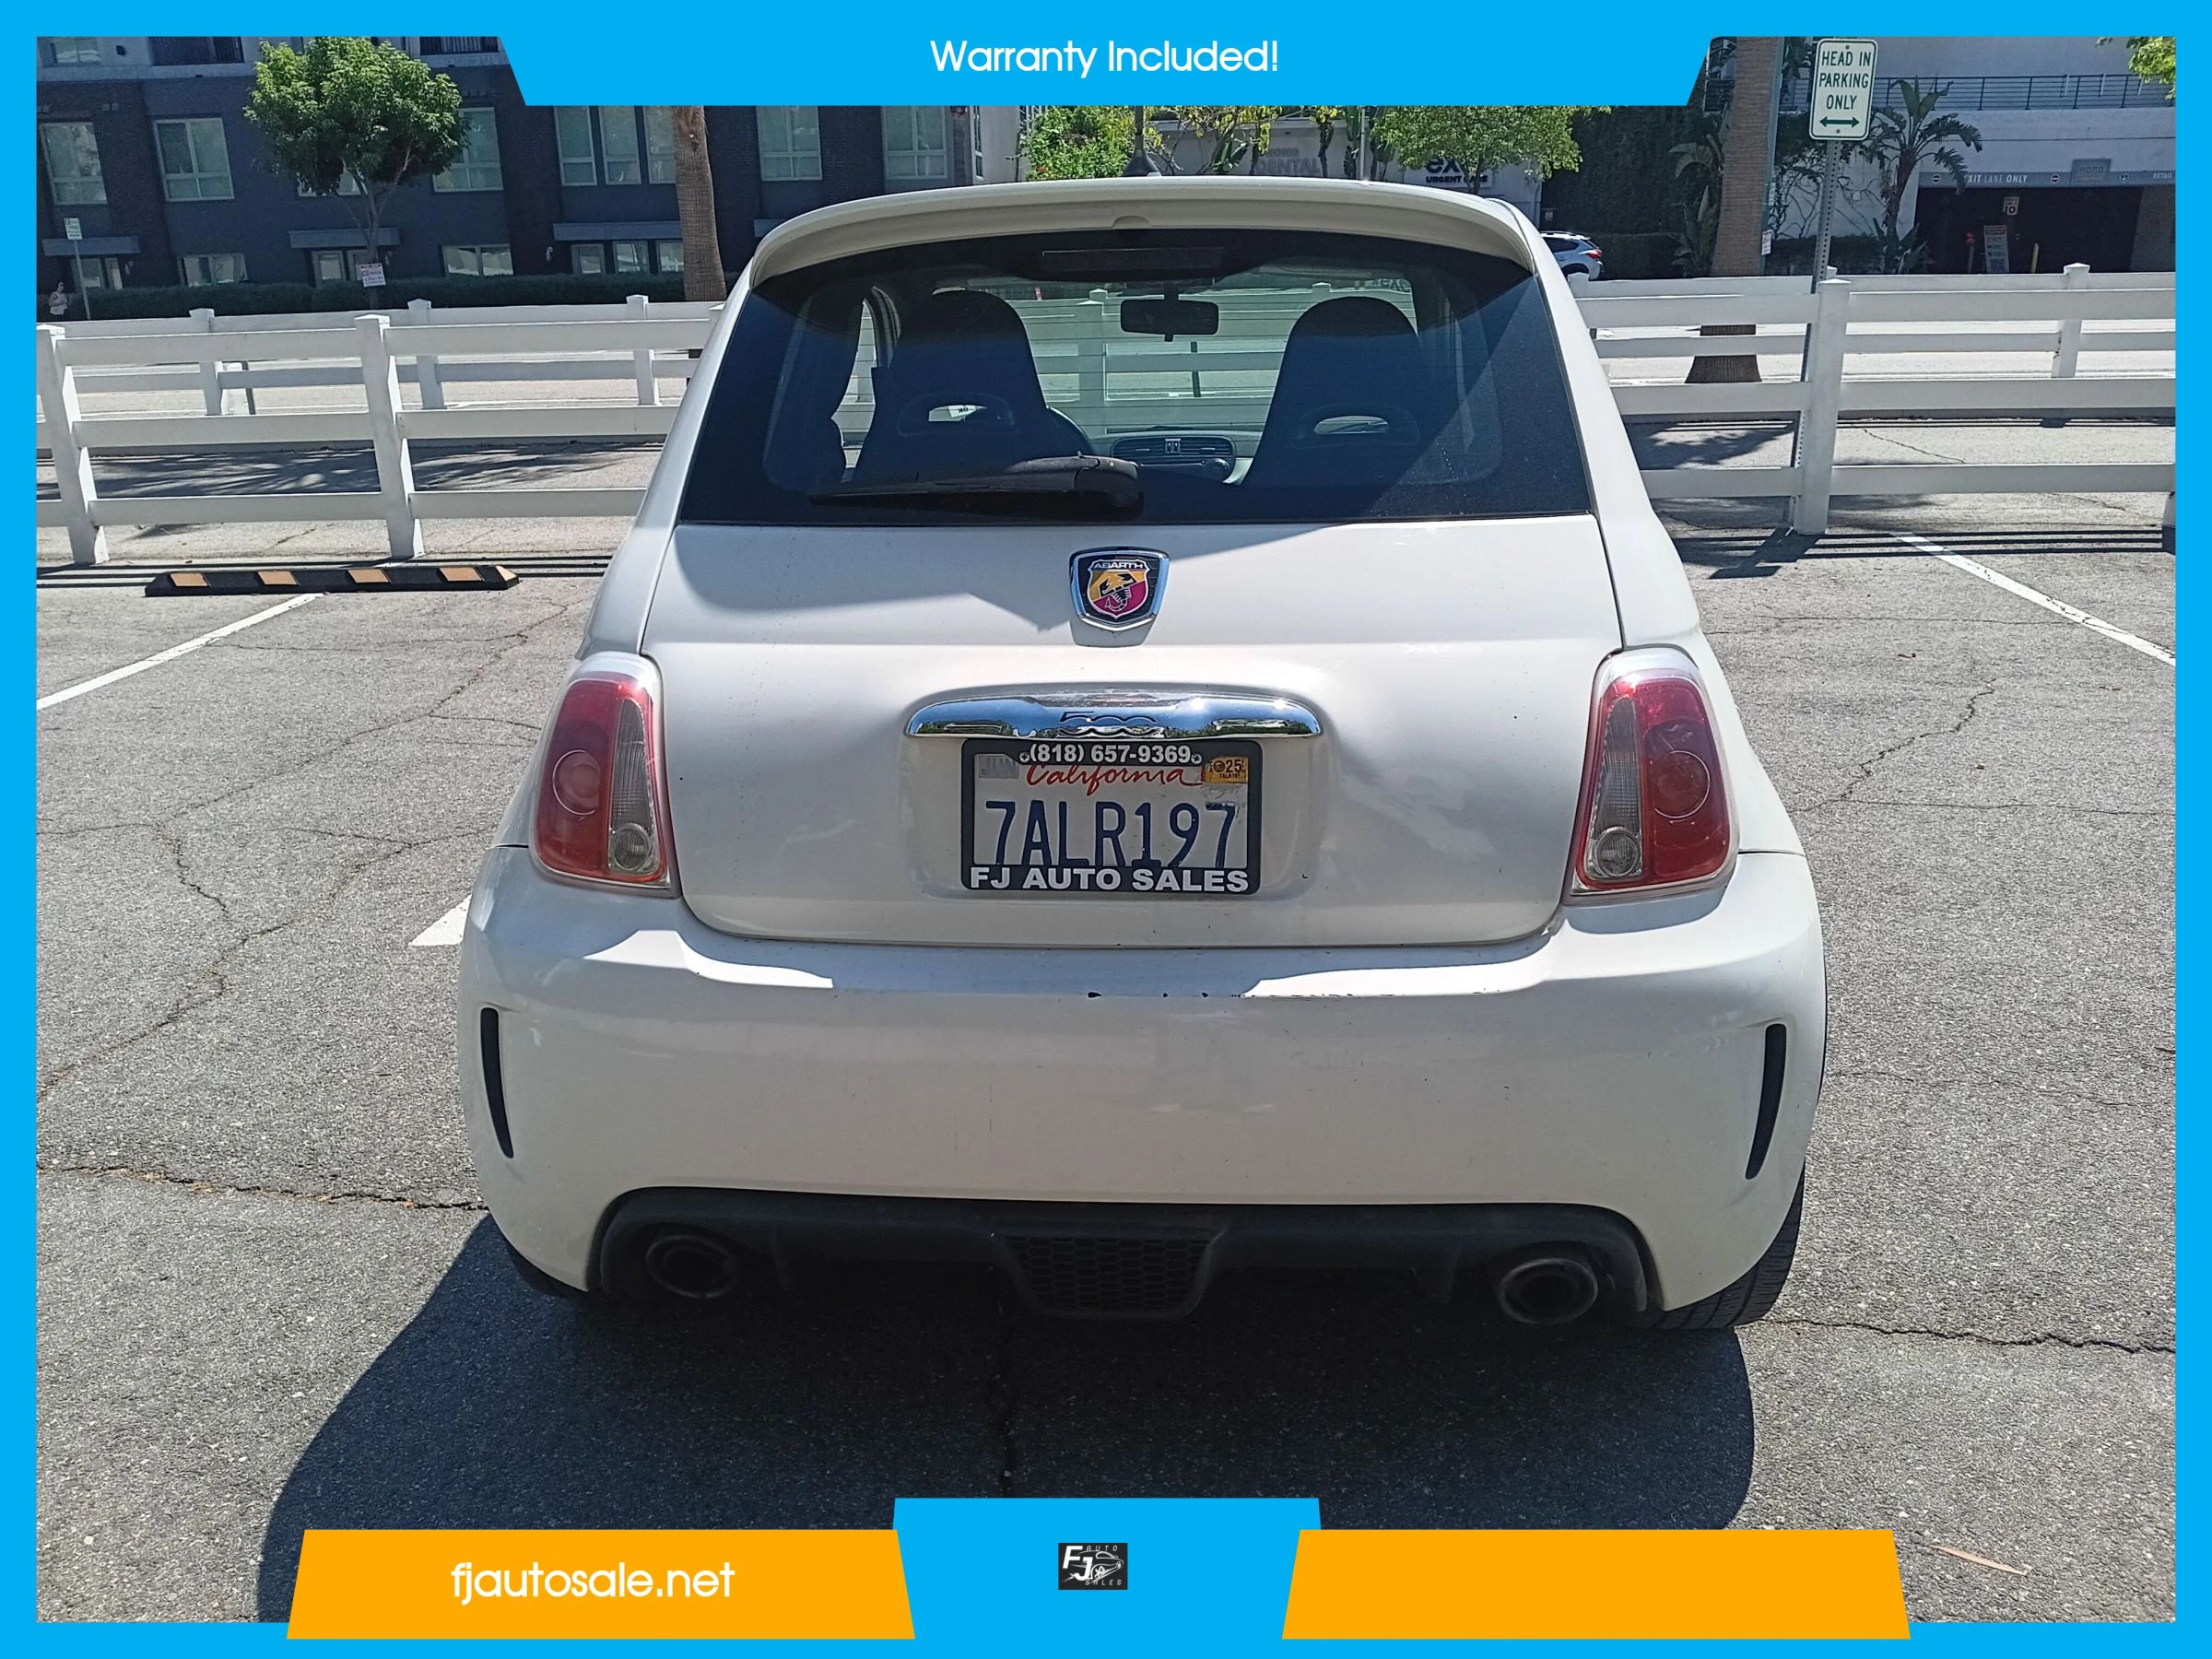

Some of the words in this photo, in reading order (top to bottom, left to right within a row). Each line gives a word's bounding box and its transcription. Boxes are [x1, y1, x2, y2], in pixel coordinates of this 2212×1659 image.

[1821, 51, 1853, 66] HEAD
[1859, 51, 1872, 66] IN
[1818, 73, 1869, 88] PARKING
[1826, 94, 1857, 110] ONLY
[1255, 158, 1321, 173] DENTAL
[1426, 175, 1462, 183] URGENT
[1965, 174, 1982, 183] XIT
[1984, 175, 2003, 183] LANE
[2006, 174, 2028, 183] ONLY
[2005, 206, 2016, 214] 10
[1030, 744, 1085, 763] (818)
[1091, 745, 1191, 764] 657-9369
[1225, 759, 1241, 772] 25
[1026, 763, 1203, 796] California
[985, 799, 1237, 869] 7ALR197
[971, 866, 1010, 888] FJ
[1022, 867, 1121, 889] AUTO
[1132, 868, 1249, 892] SALES
